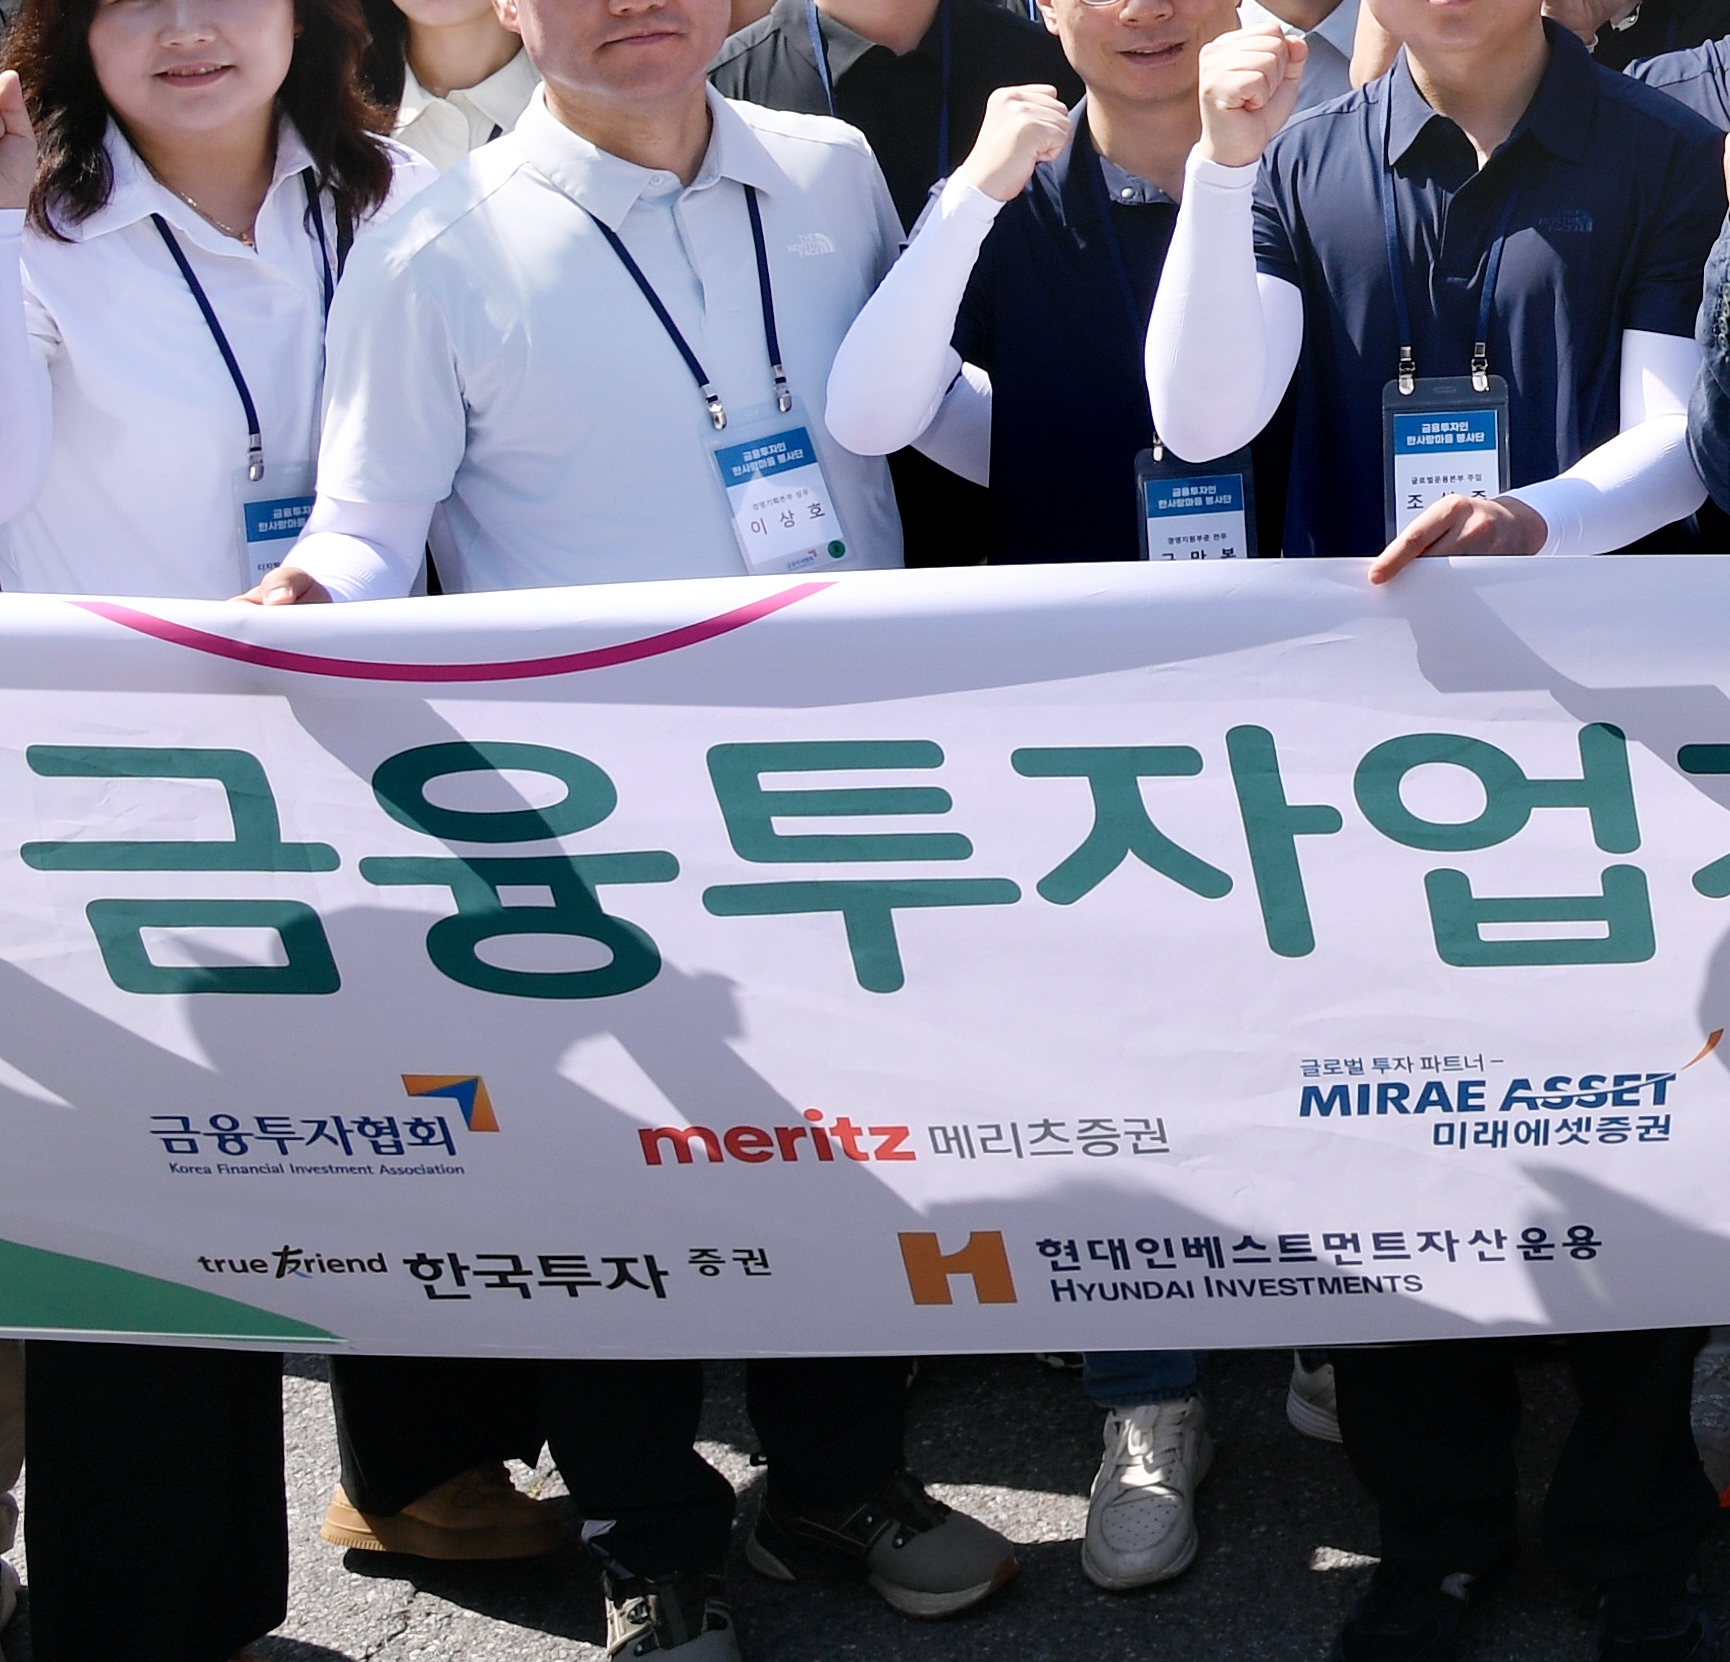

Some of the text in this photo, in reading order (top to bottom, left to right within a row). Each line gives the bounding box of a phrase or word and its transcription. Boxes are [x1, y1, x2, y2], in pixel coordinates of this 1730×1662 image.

[1406, 433, 1453, 446] 한사랑마을
[1421, 421, 1469, 433] 금융투자인
[742, 442, 787, 462] 금융투자인
[732, 457, 776, 477] 한사랑마을
[1158, 497, 1203, 509] 한사랑마을
[1172, 485, 1217, 497] 금융투자인
[1299, 1053, 1485, 1078] 글로벌 투자 파트너
[1298, 1072, 1677, 1117] MIRAE ASSET
[149, 1114, 458, 1157] 금융투자협회
[637, 1107, 917, 1166] meritz
[927, 1117, 1170, 1160] 메리츠증권
[1432, 1114, 1673, 1149] 미래에셋증권
[168, 1161, 465, 1176] Korea Financial Investment Association
[1035, 1225, 1603, 1272] 현대인베스트먼트자산운용
[402, 1247, 773, 1300] 한국투자 증권
[1050, 1272, 1424, 1304] HYUNDAI INVESTMENTS
